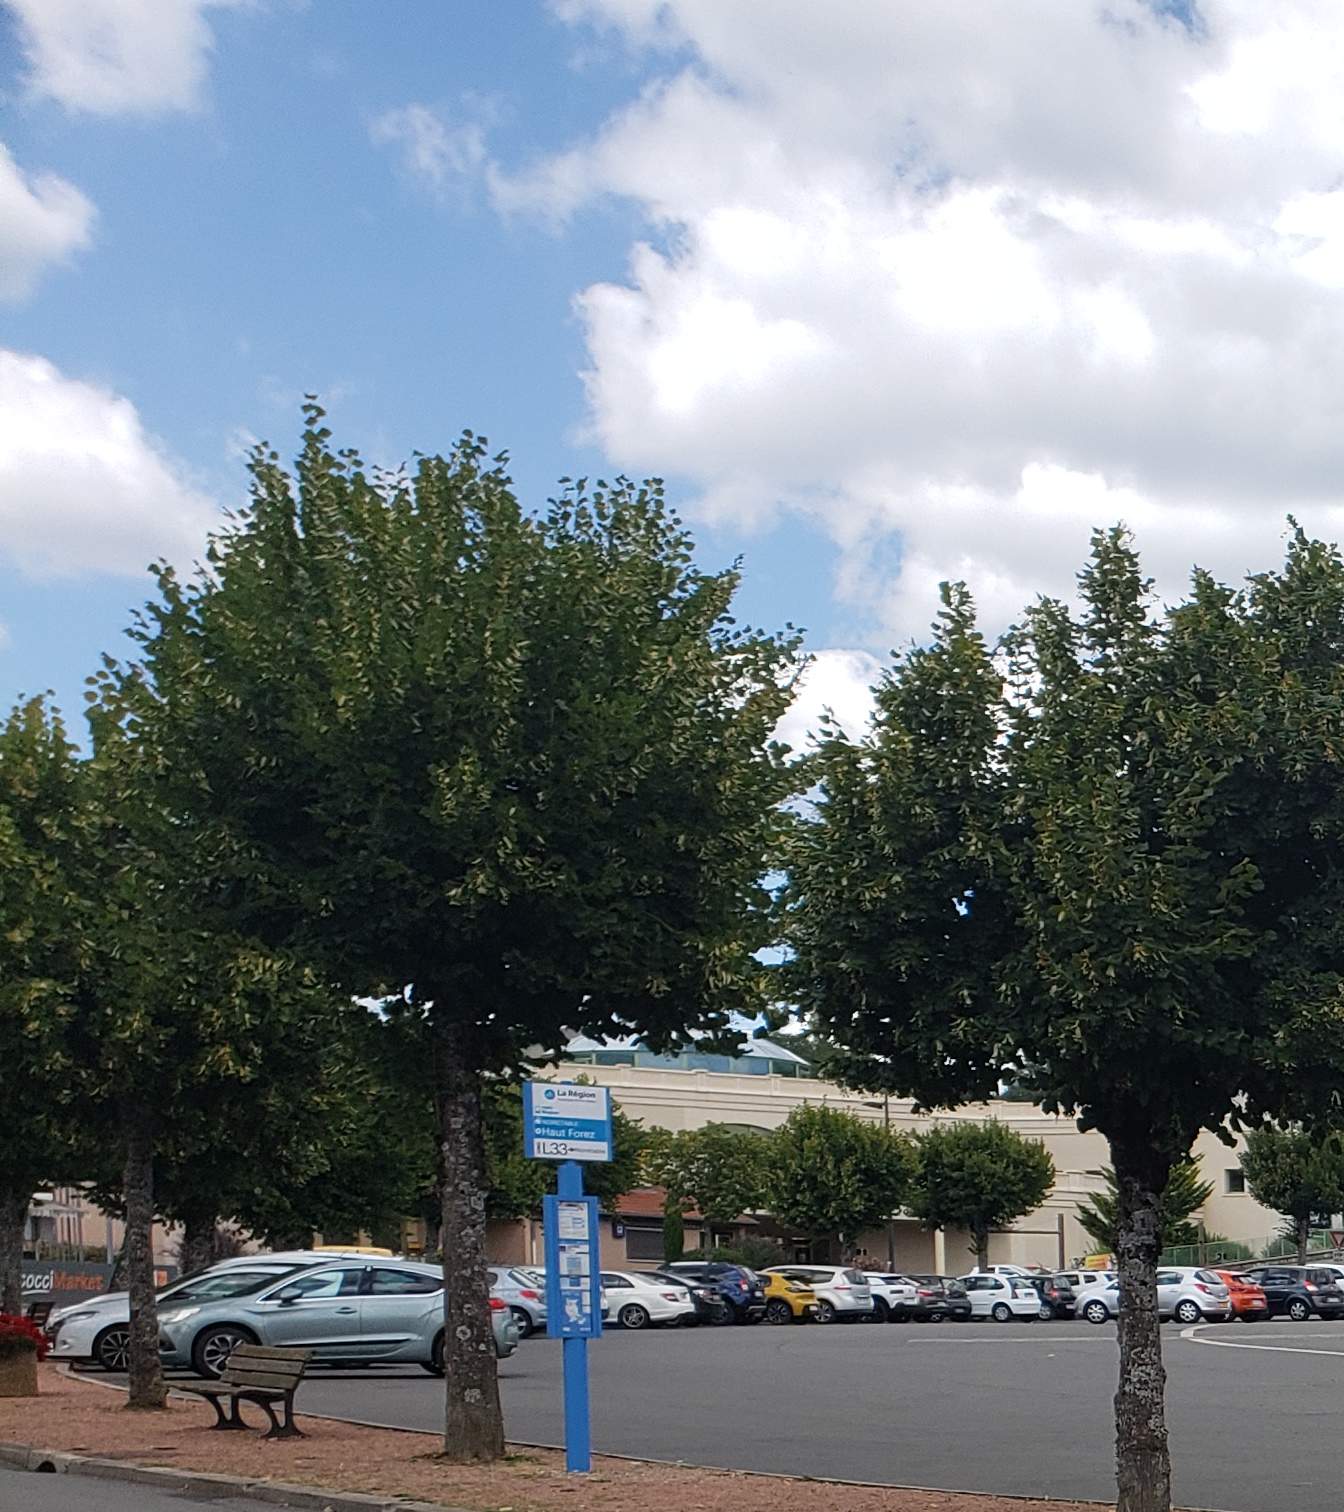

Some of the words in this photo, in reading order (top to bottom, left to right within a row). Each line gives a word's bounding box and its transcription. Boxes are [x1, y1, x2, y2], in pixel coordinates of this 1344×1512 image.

[557, 1089, 567, 1097] La
[568, 1090, 596, 1099] Région
[542, 1127, 566, 1137] Haut
[568, 1129, 596, 1139] Forez
[542, 1141, 568, 1156] L33
